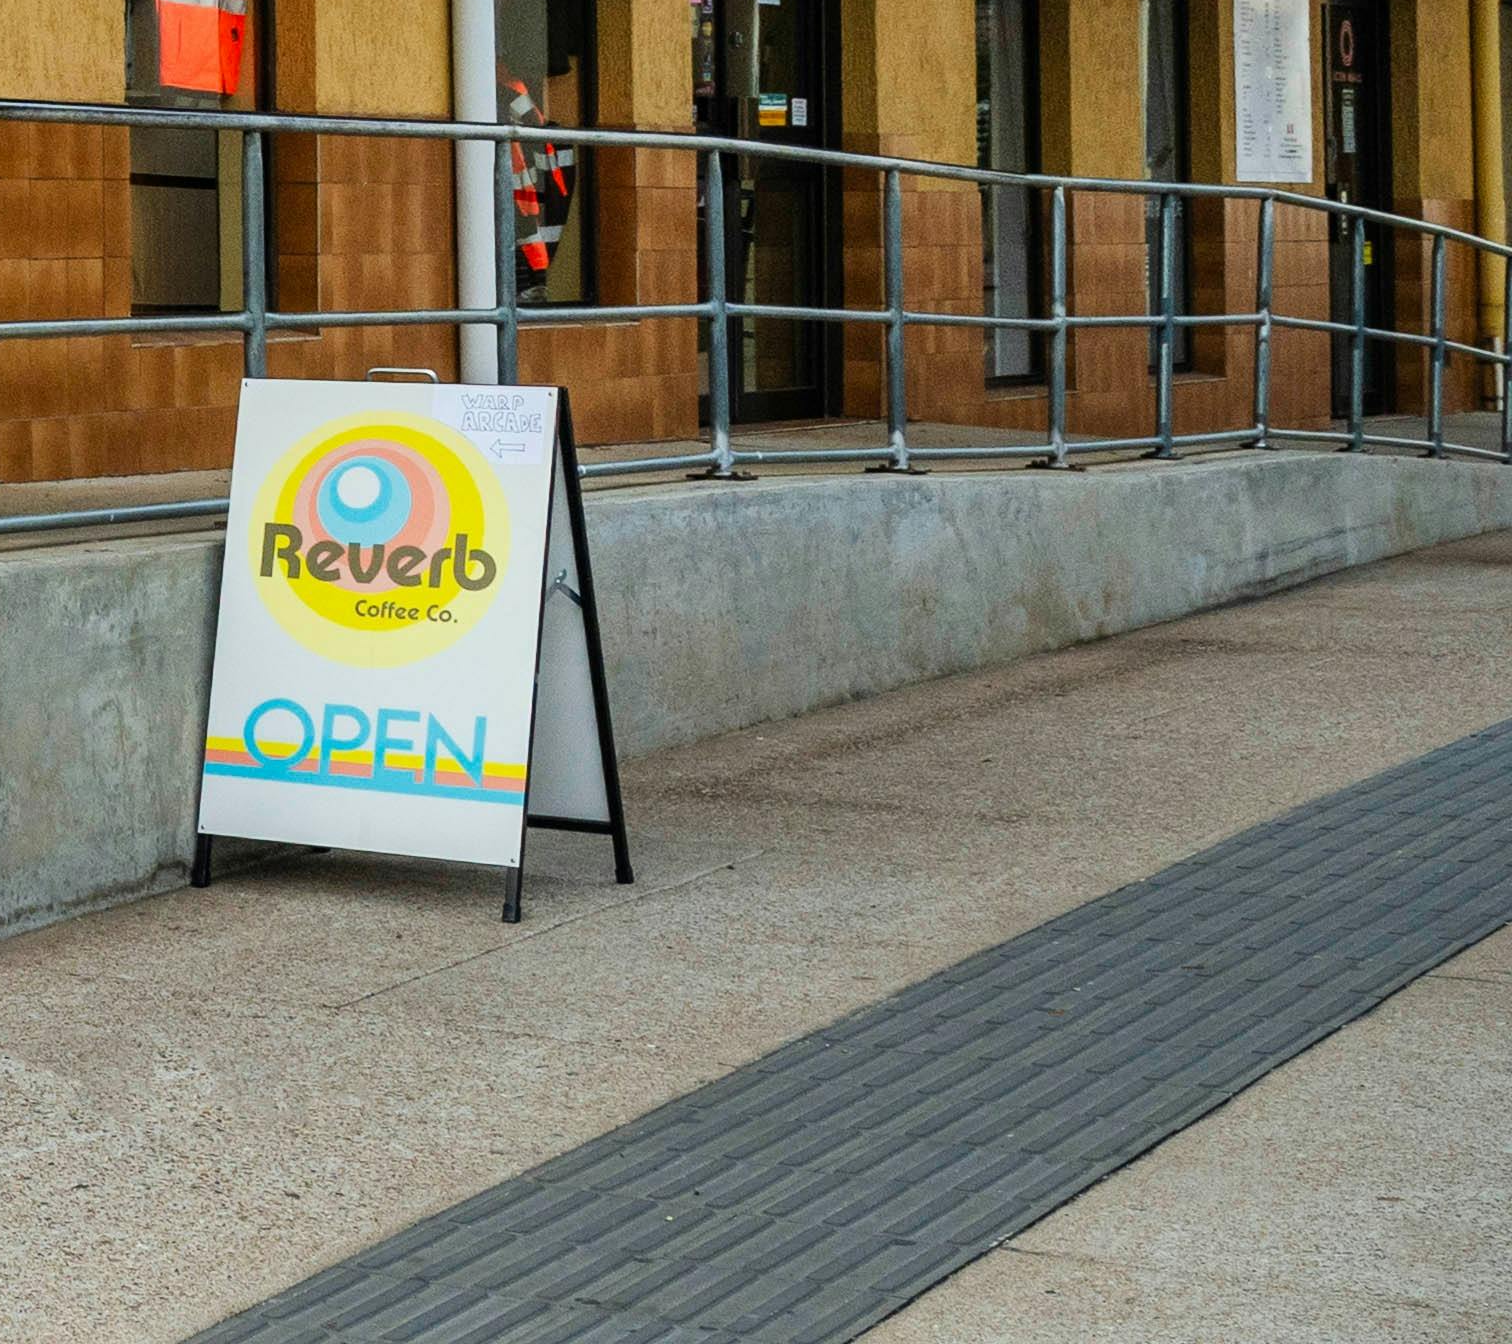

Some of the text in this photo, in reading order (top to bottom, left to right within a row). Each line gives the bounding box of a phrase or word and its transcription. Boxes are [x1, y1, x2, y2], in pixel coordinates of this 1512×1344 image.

[461, 393, 524, 411] WARP
[461, 411, 543, 433] ARCADE
[259, 522, 498, 592] Reverb
[354, 599, 459, 625] Coffee Co.
[243, 697, 488, 792] OPEN
